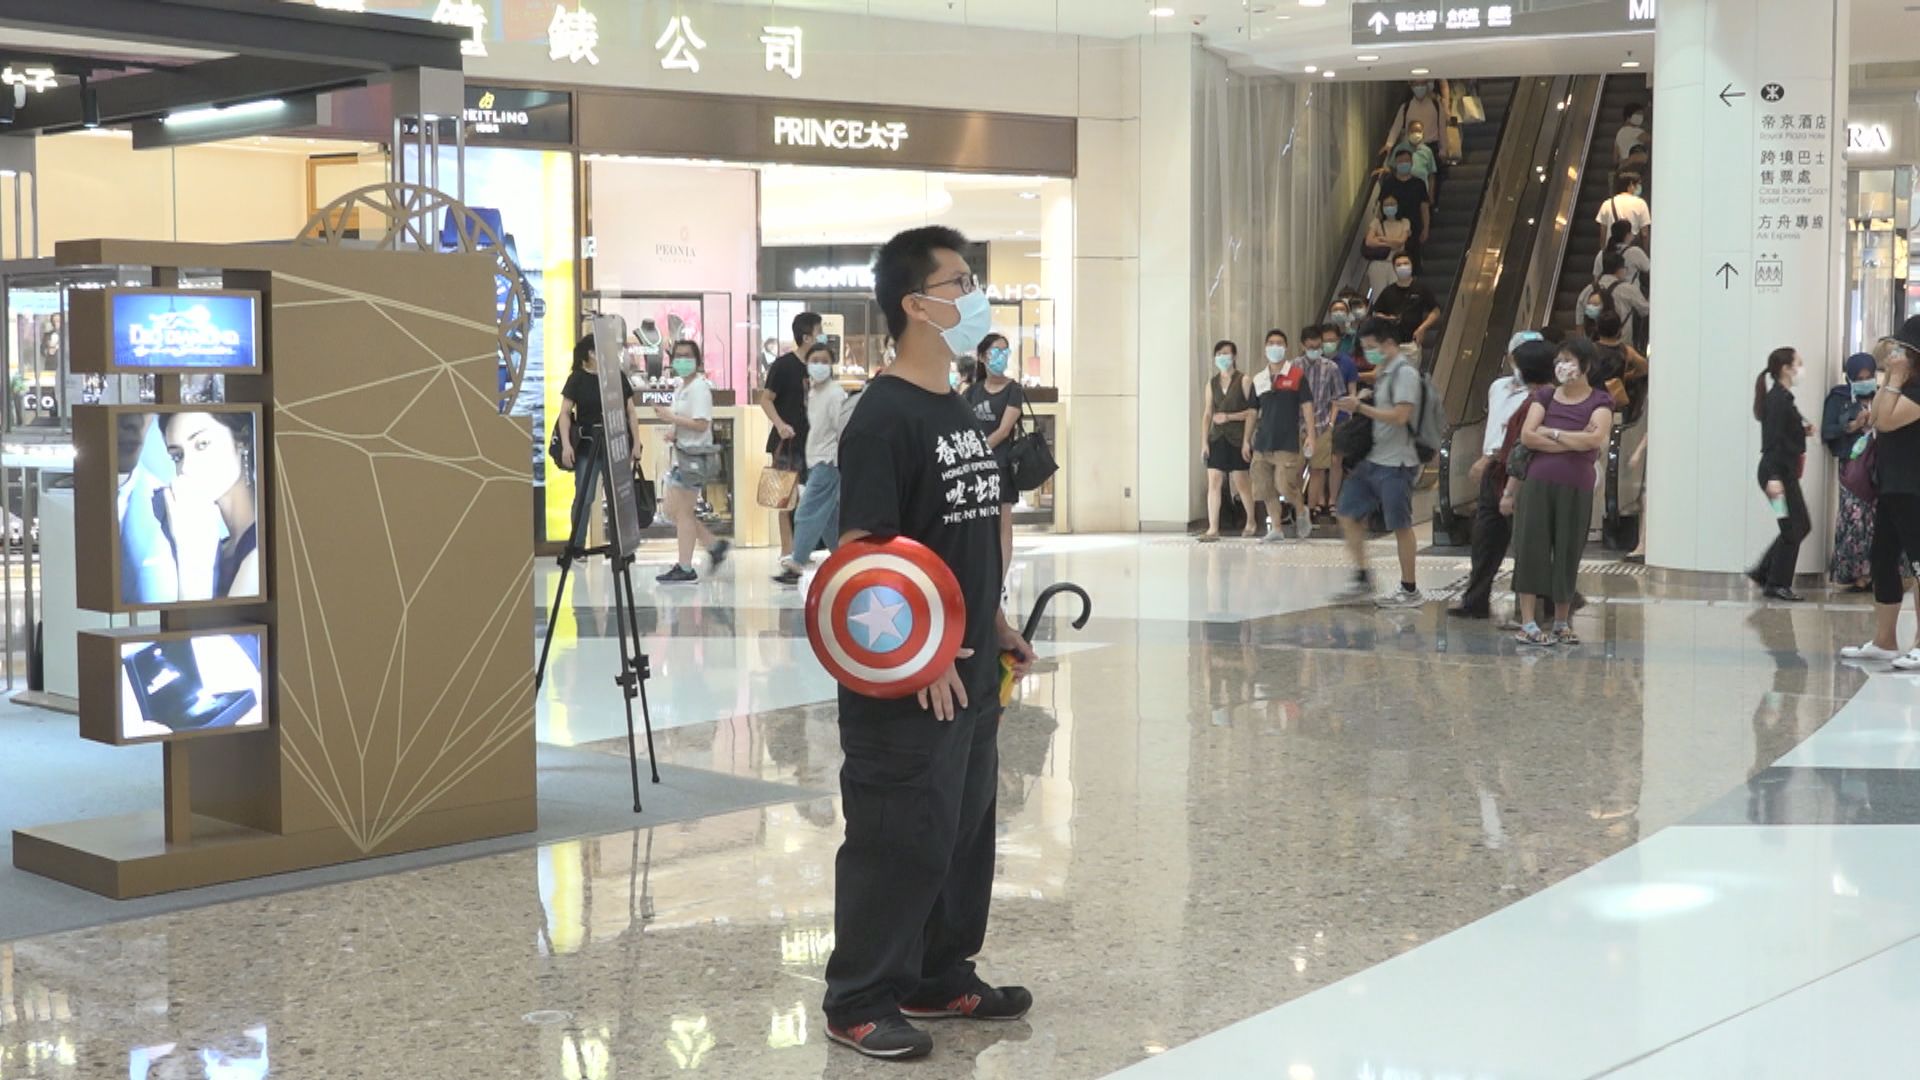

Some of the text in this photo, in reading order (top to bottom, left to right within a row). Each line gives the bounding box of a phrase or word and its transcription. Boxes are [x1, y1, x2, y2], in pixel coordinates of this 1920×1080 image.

[1761, 114, 1826, 129] 帝京酒店
[1760, 150, 1824, 165] 跨境巴士
[1760, 169, 1811, 185] 售票處
[1758, 214, 1824, 229] 方舟專線
